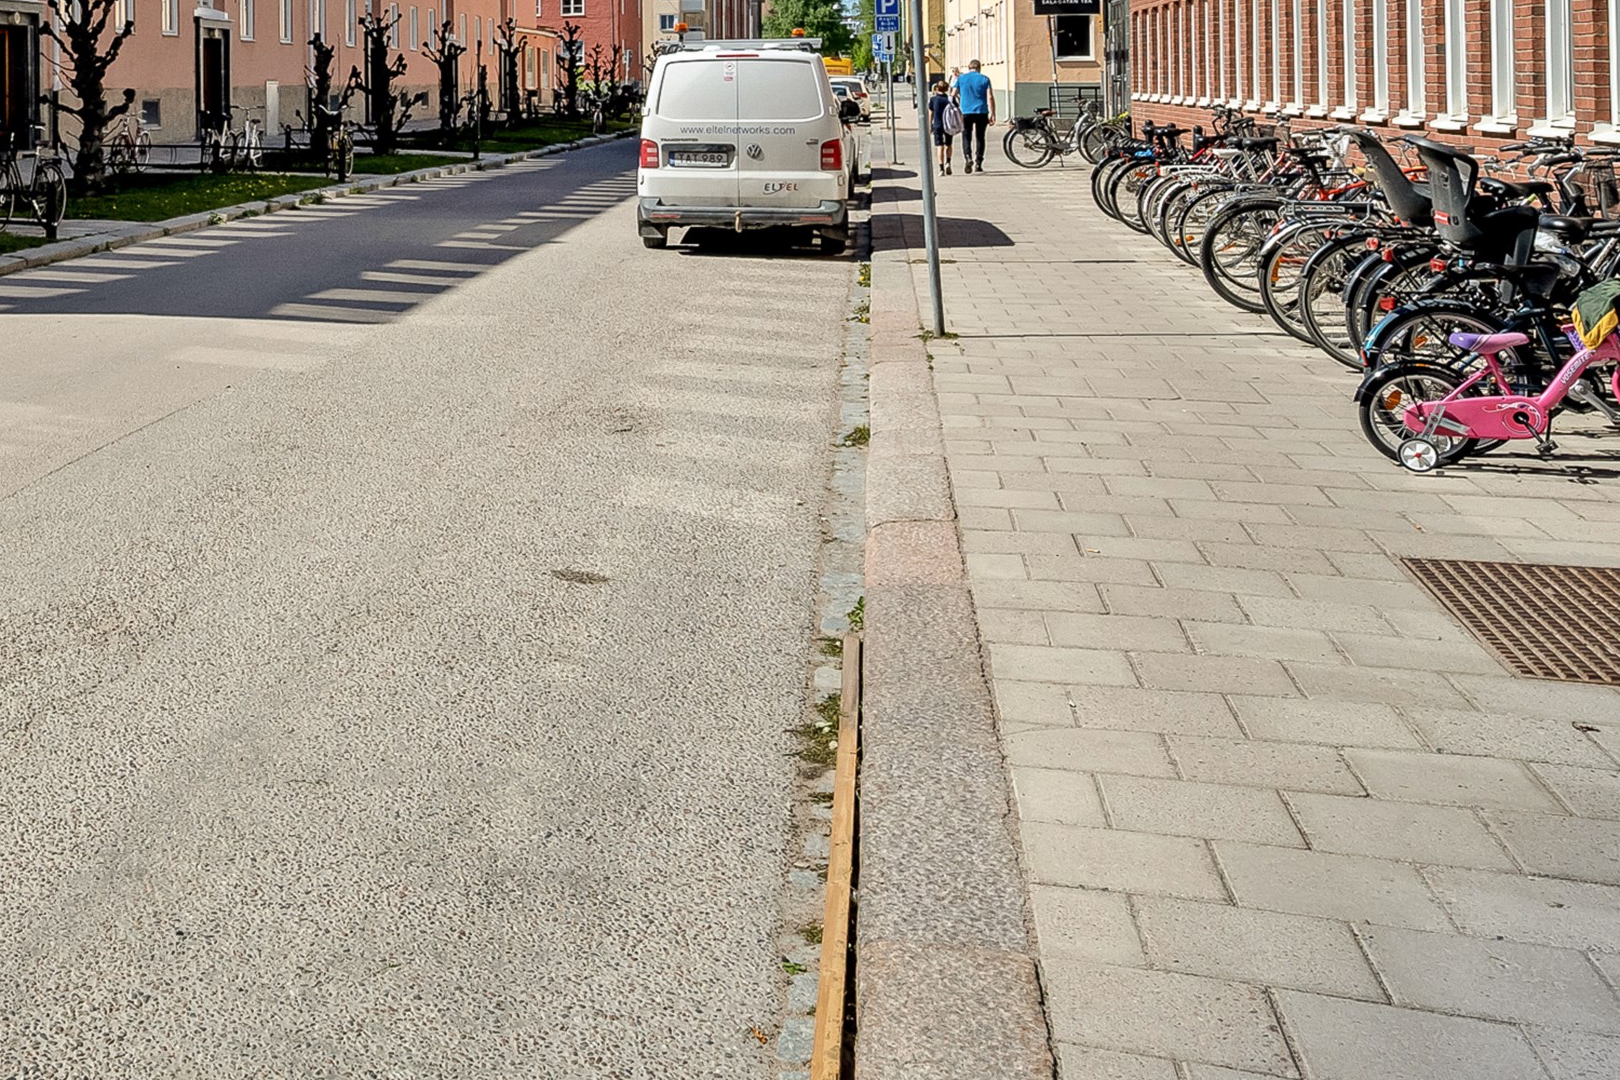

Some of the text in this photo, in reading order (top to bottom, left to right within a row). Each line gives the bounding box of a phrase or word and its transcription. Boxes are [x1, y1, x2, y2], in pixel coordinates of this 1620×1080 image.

[680, 125, 796, 135] www.eltelnetworks.com
[701, 154, 723, 163] 989
[764, 182, 799, 192] ELTEL
[1560, 352, 1592, 385] YOSEMITE
